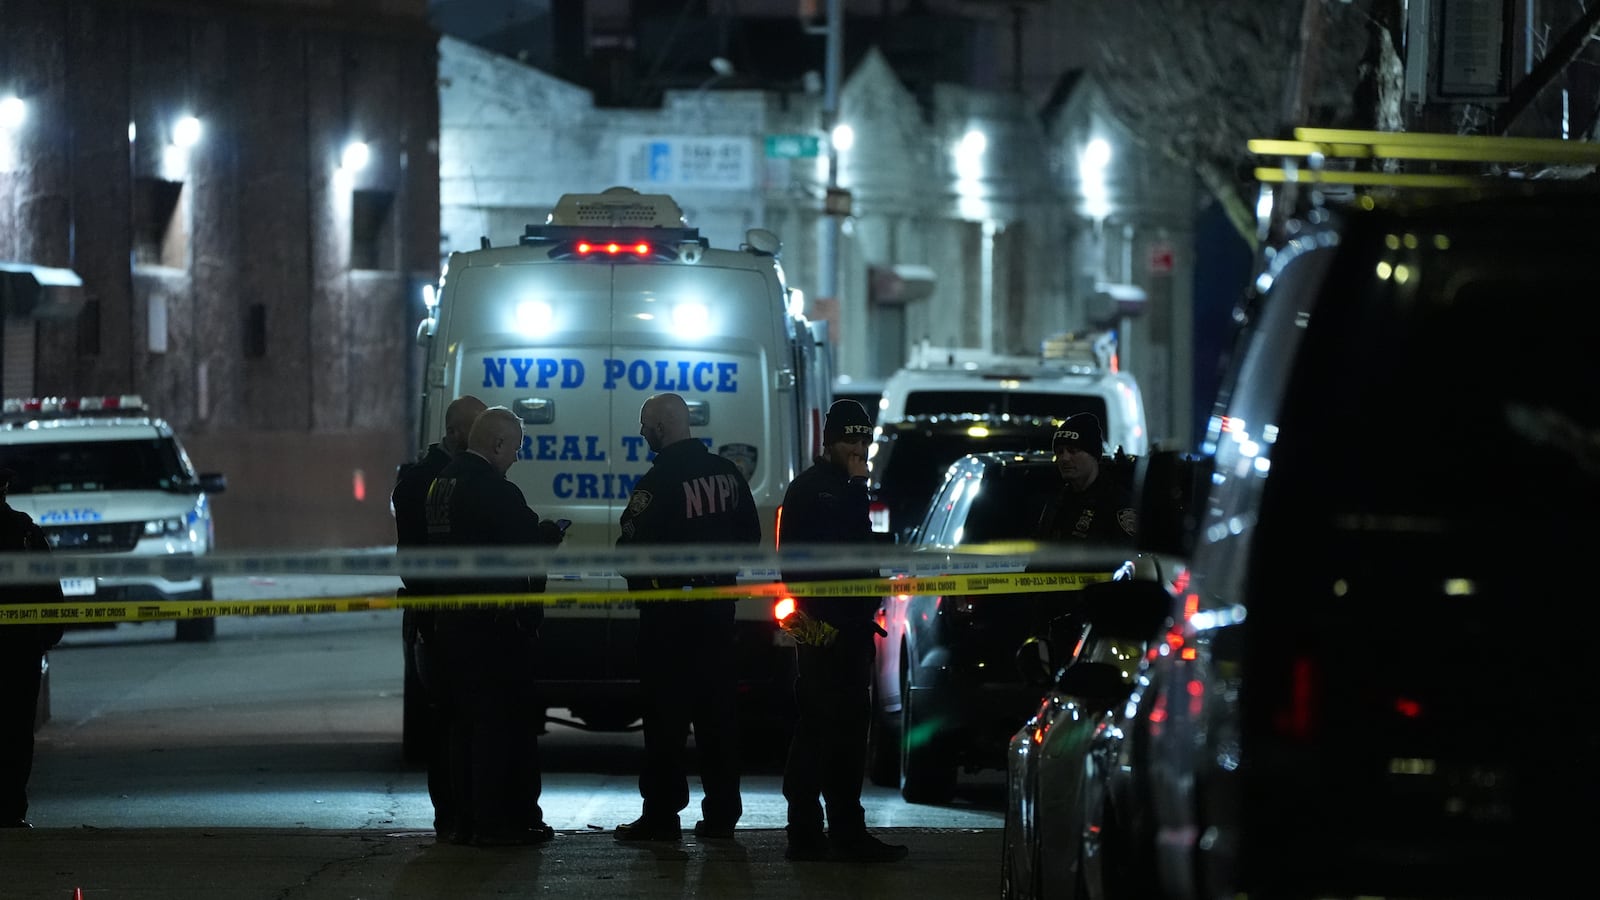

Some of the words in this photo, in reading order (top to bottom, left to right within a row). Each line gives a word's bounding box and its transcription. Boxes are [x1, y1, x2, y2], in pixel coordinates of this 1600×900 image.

[483, 358, 585, 389] NYPD
[603, 359, 738, 393] POLICE
[517, 435, 605, 461] REAL
[553, 473, 643, 499] CRIM
[682, 473, 741, 519] NYPD
[41, 608, 59, 618] CRIME
[60, 608, 79, 617] SCENE
[85, 608, 93, 616] DO
[95, 608, 105, 616] NOT
[107, 607, 126, 617] CROSS
